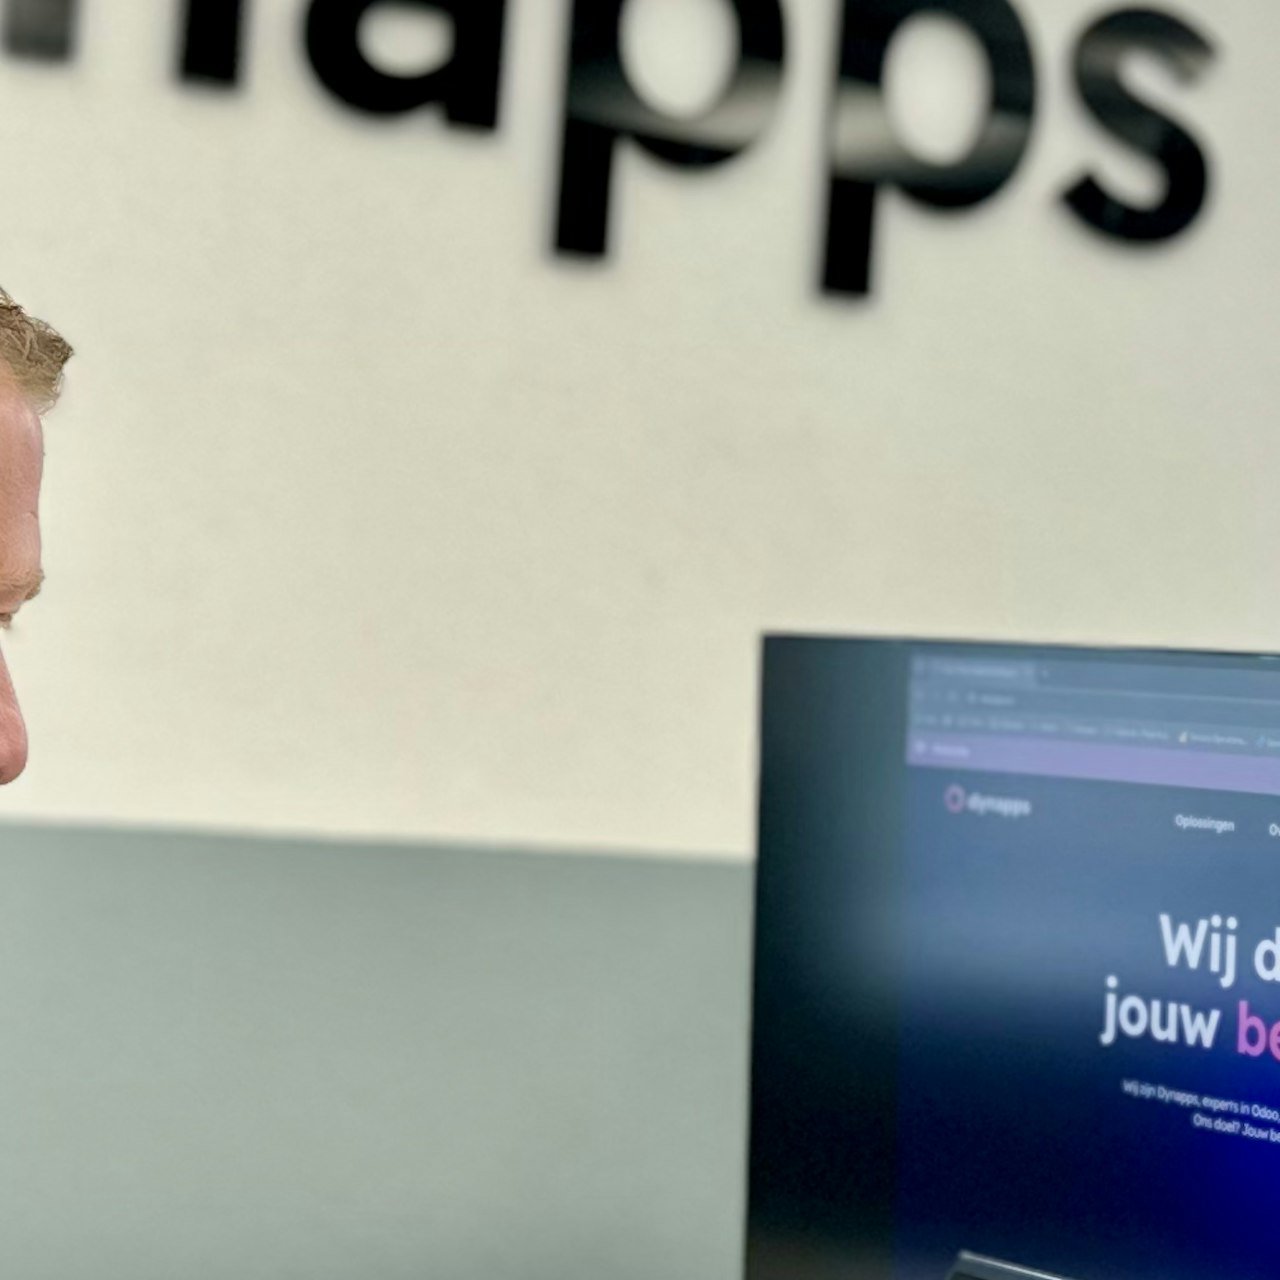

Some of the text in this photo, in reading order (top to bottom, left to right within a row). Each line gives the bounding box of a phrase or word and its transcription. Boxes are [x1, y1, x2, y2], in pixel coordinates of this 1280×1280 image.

[1175, 814, 1235, 834] Oplossingen
[1159, 913, 1238, 988] Wij
[1100, 975, 1221, 1048] jouw
[1122, 1080, 1138, 1096] Wij
[1157, 1086, 1200, 1108] Dynapps,
[1240, 1100, 1250, 1114] in
[1251, 1104, 1280, 1123] Odoo,
[1193, 1113, 1213, 1129] Ons
[1214, 1117, 1241, 1135] doel?
[1242, 1123, 1269, 1140] Jouw
